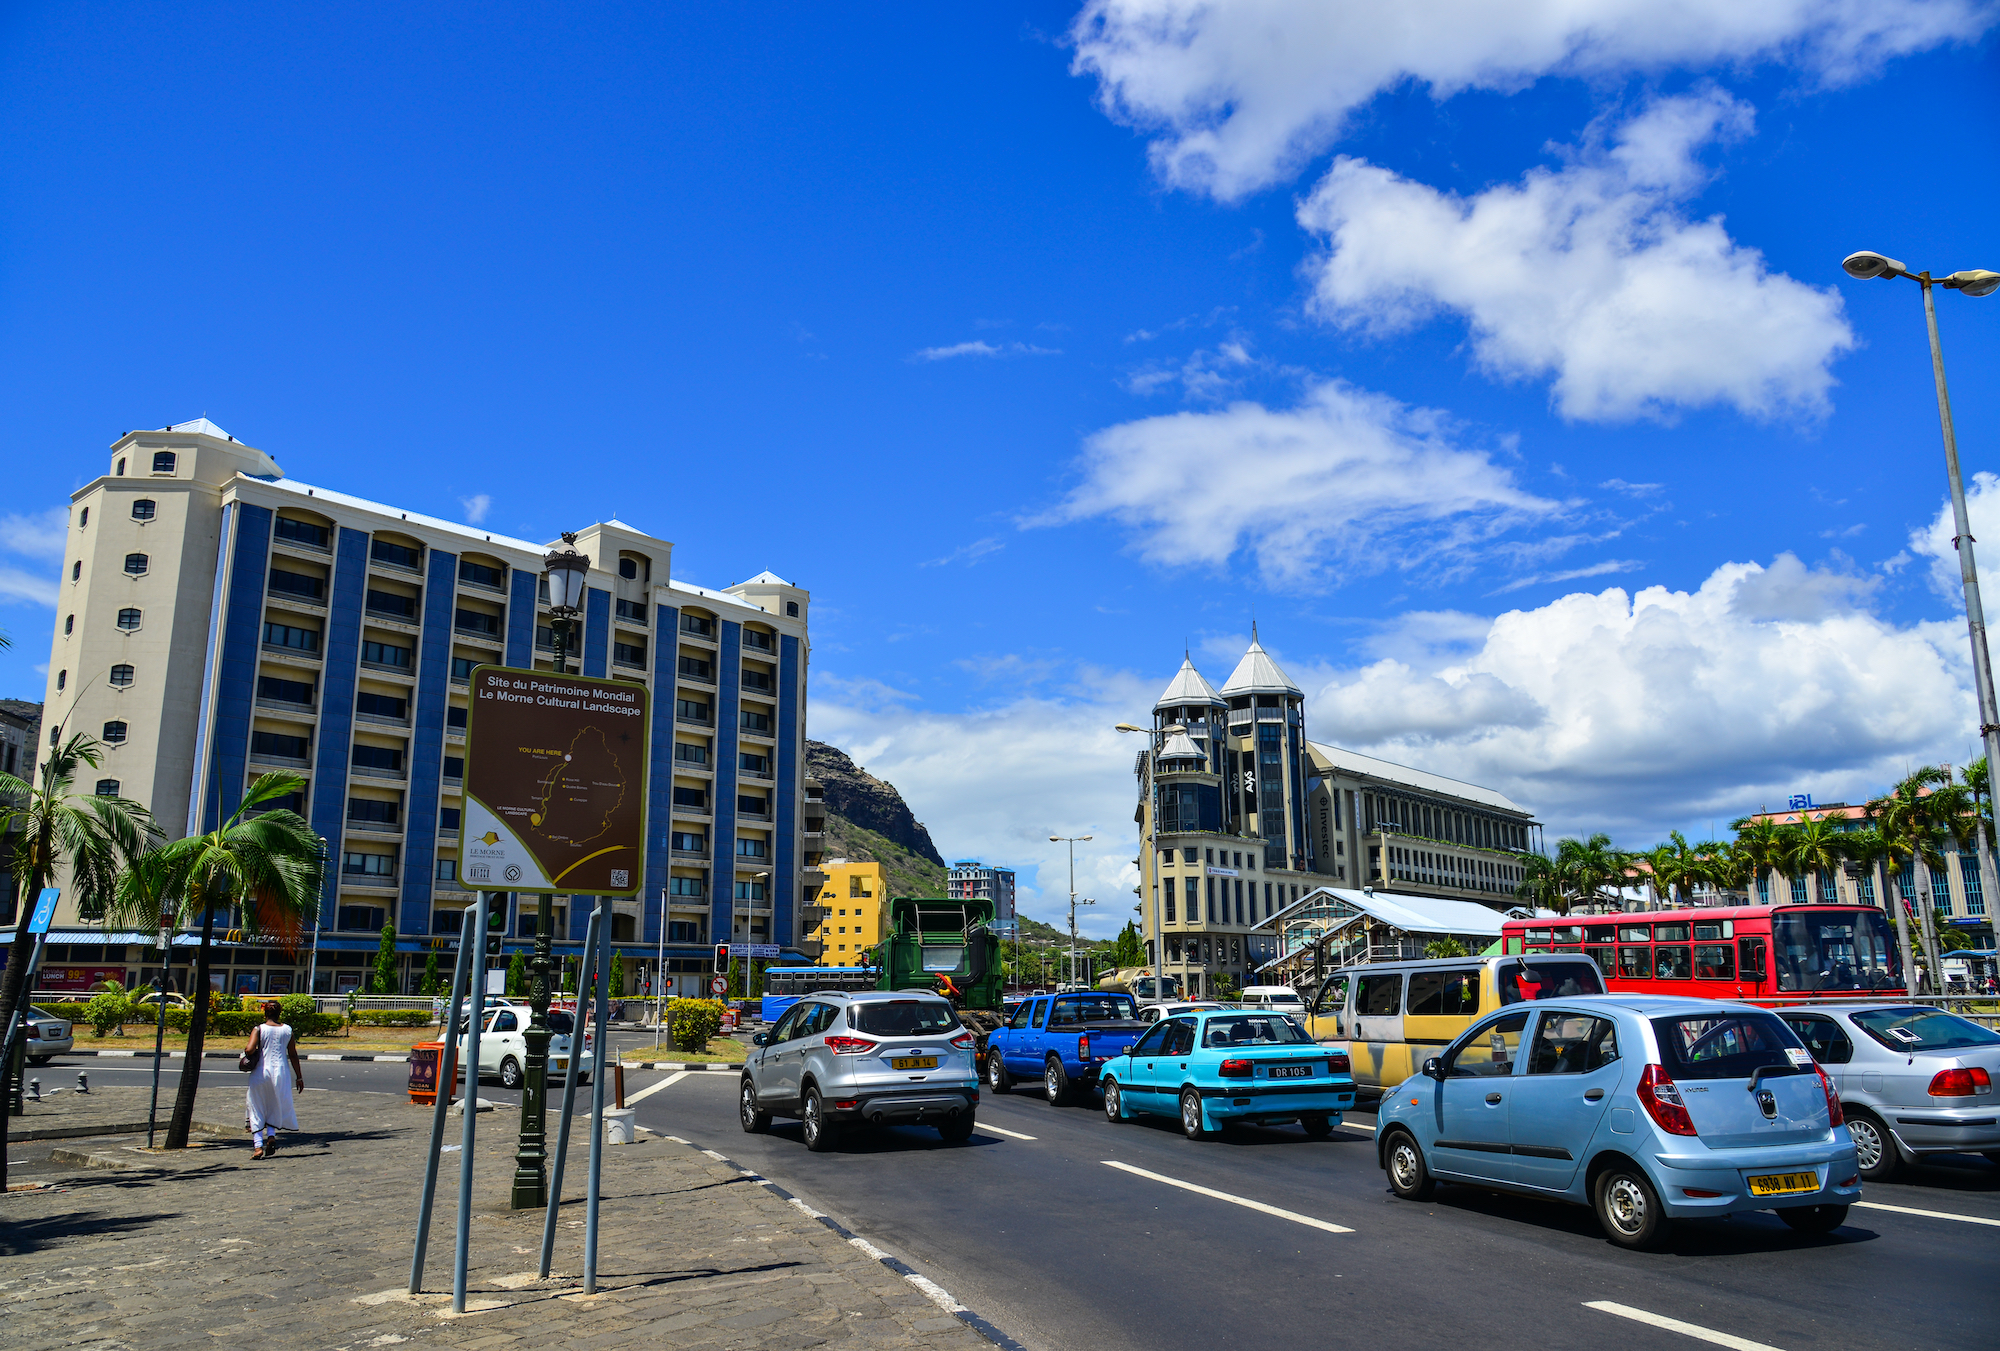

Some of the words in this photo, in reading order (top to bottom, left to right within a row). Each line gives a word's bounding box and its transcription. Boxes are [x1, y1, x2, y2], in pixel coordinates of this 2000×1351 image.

[487, 675, 511, 688] Site
[513, 679, 528, 690] du
[530, 681, 590, 698] Patrimoine
[592, 688, 635, 703] Mondial
[479, 688, 494, 700] Le
[496, 690, 534, 704] Morne
[536, 694, 580, 710] Cultural
[583, 700, 641, 716] Landscape
[518, 746, 532, 754] YOU
[545, 749, 563, 757] HERE
[1320, 807, 1331, 859] Investec
[479, 849, 506, 857] MORNE
[67, 969, 80, 980] 99
[899, 1059, 909, 1068] 61
[911, 1058, 920, 1067] JN
[923, 1058, 931, 1067] 14
[1275, 1067, 1288, 1077] DR
[1289, 1067, 1306, 1077] 105
[1757, 1177, 1781, 1192] 6938
[1800, 1174, 1812, 1189] 11
